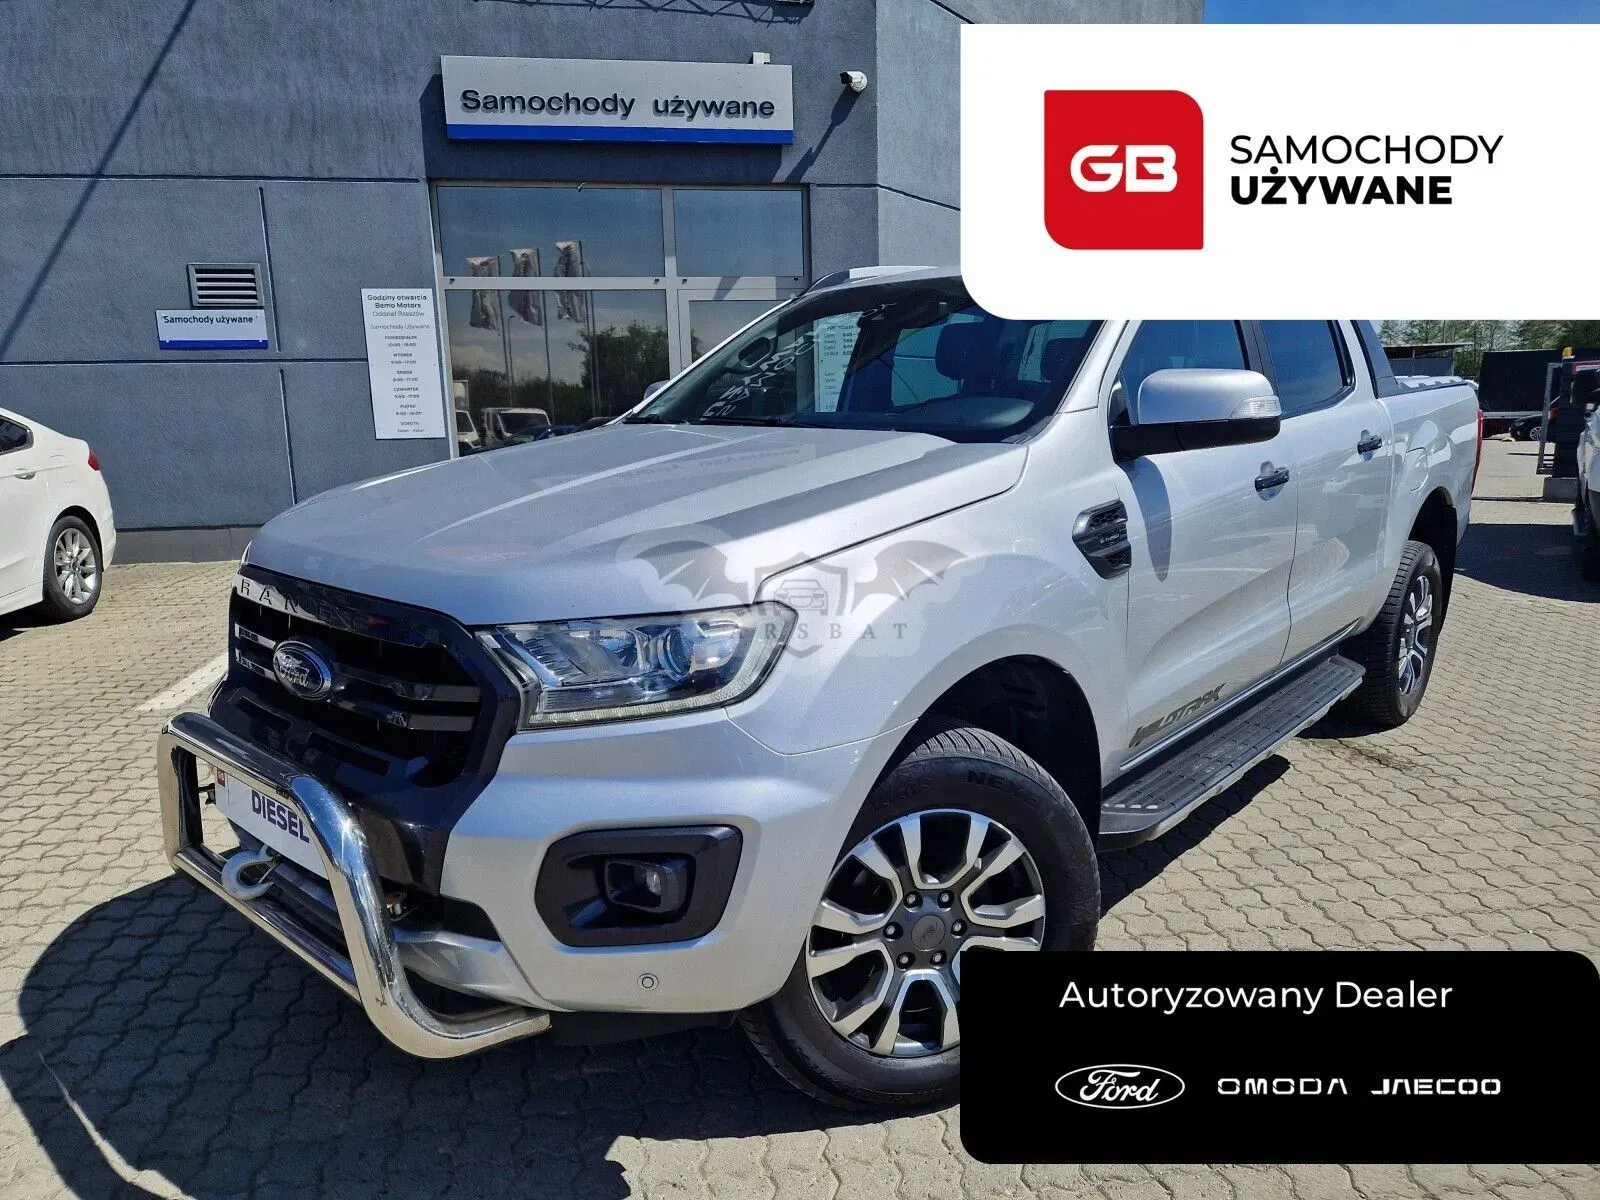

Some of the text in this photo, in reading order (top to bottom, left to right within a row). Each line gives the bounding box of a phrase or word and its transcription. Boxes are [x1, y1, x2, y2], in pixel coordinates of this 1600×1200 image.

[460, 89, 775, 121] Samochody używane
[367, 294, 396, 302] Godziny
[163, 315, 254, 325] Samochody używane
[251, 789, 310, 843] DIESEL
